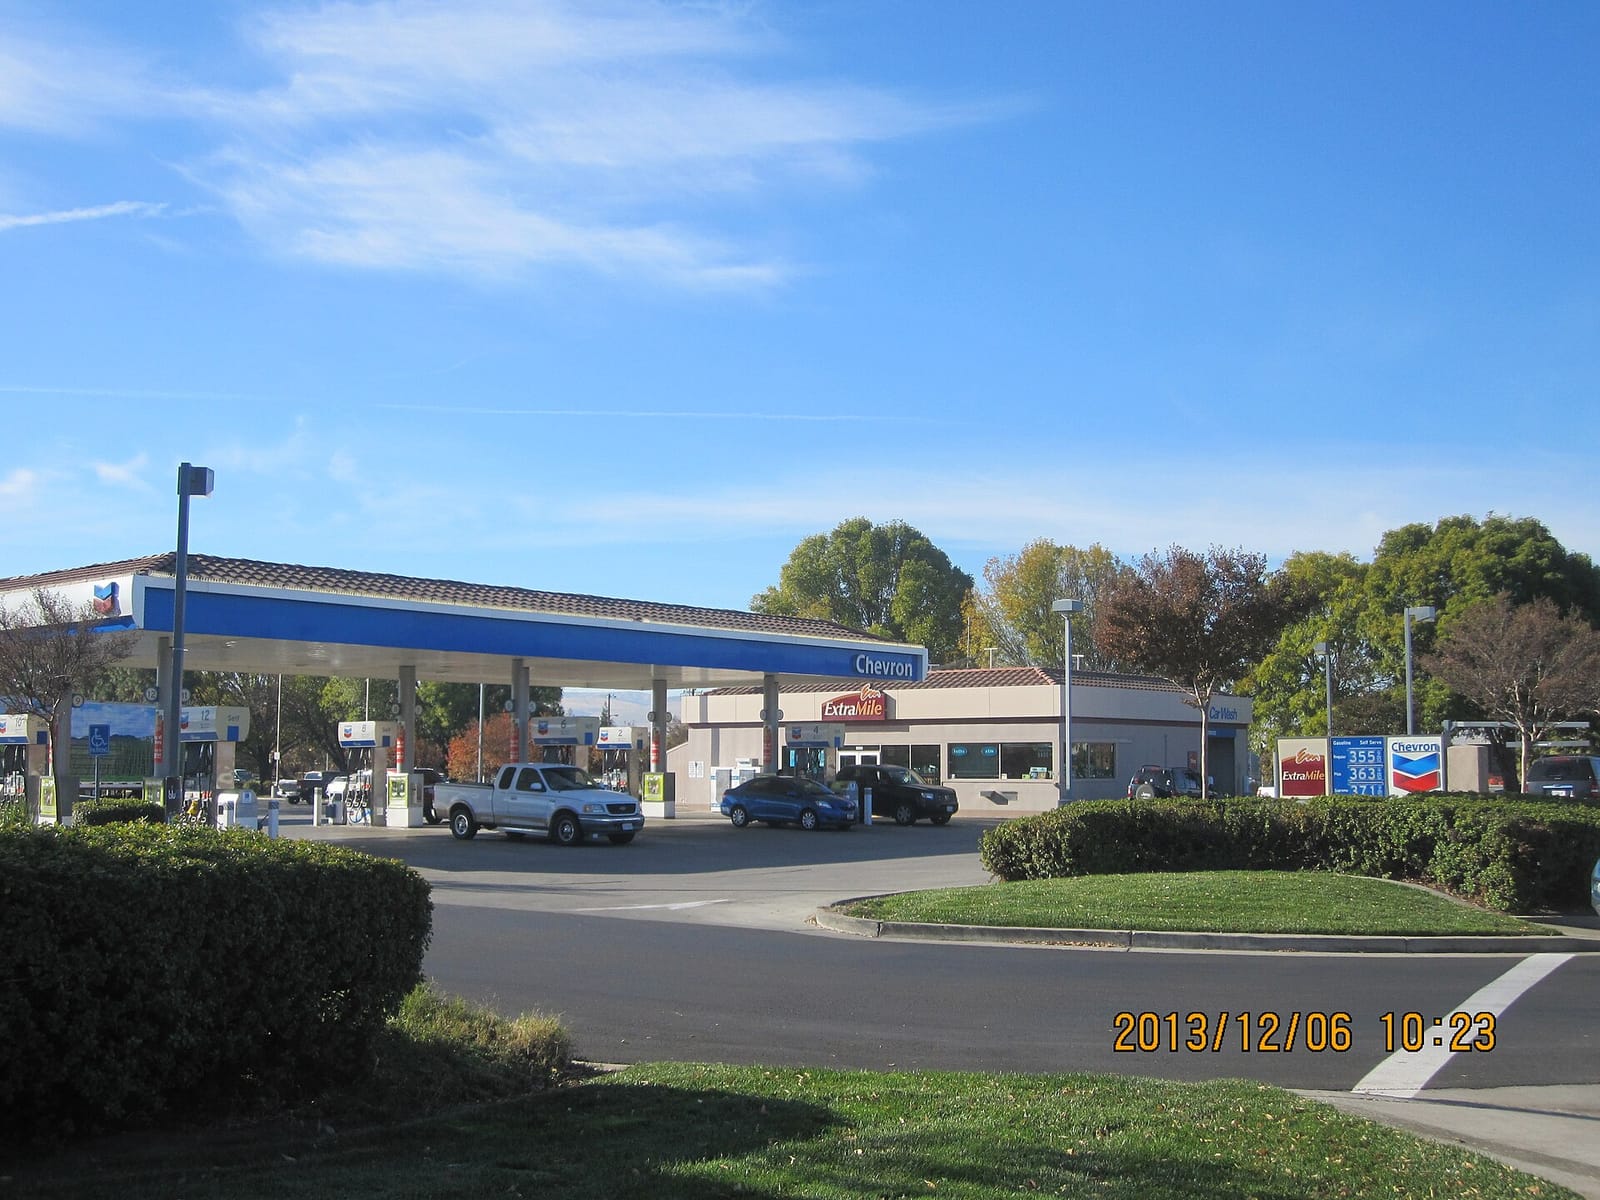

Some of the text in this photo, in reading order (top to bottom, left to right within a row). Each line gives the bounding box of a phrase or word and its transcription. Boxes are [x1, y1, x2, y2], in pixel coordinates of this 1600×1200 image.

[855, 654, 913, 678] Chevron
[824, 700, 883, 716] ExtraMile
[1209, 706, 1238, 720] Car Wash
[201, 709, 209, 721] 12
[560, 719, 567, 729] 6
[1391, 742, 1440, 752] Chevron
[1350, 750, 1376, 763] 355
[1282, 770, 1325, 781] ExtraMile
[1350, 767, 1376, 780] 363
